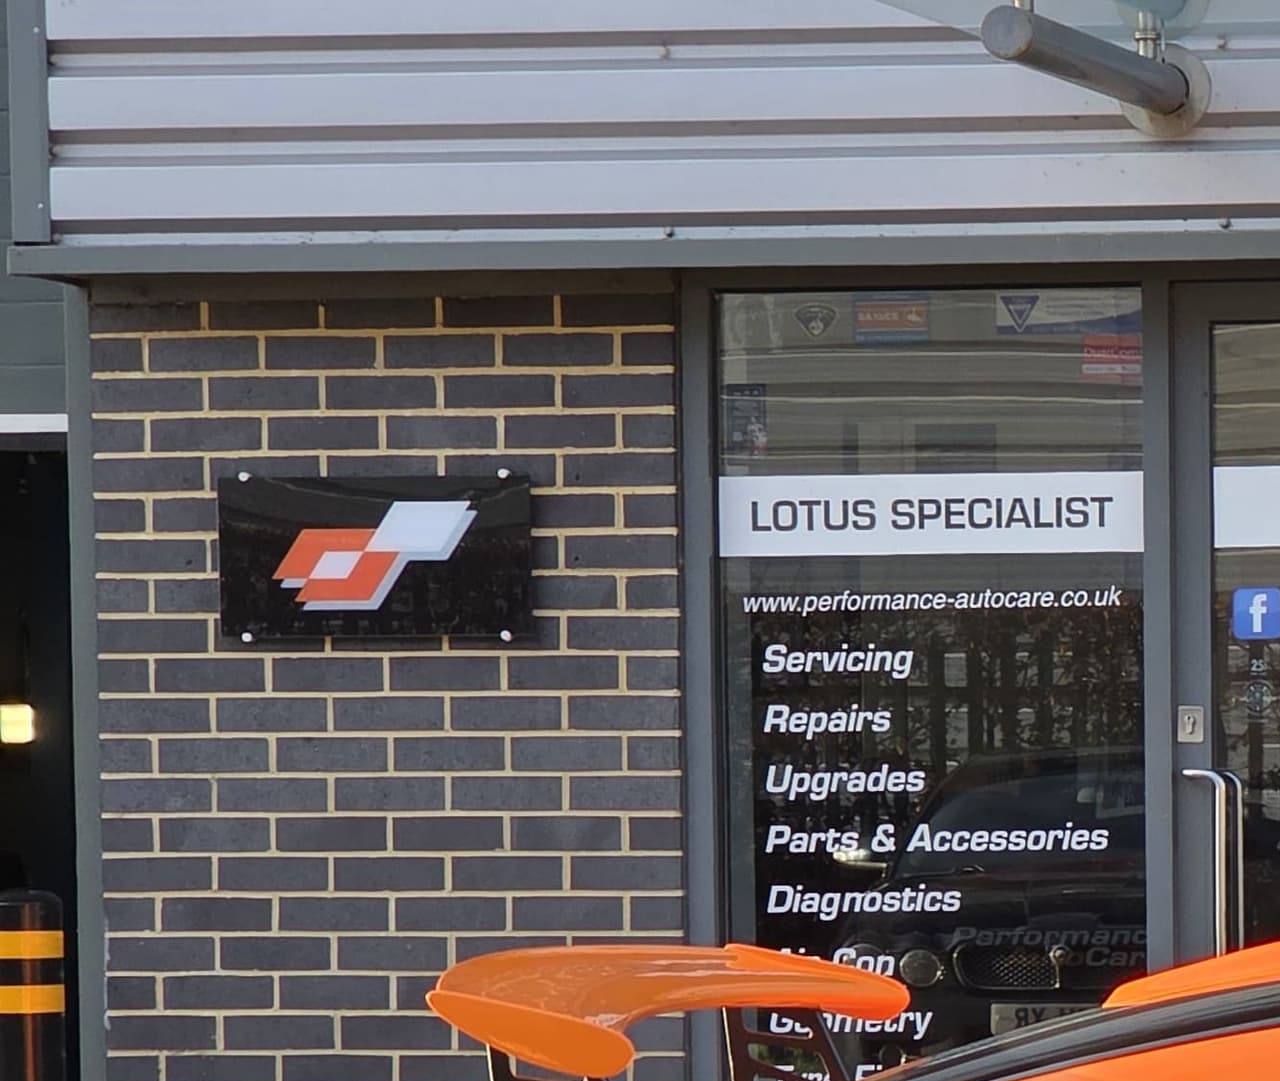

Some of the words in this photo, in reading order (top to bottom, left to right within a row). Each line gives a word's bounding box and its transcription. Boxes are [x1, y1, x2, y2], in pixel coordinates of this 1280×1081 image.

[751, 499, 876, 532] LOTUS
[891, 496, 1114, 530] SPECIALIST
[743, 585, 1122, 615] www.performance-autocare.co.uk
[762, 643, 914, 679] Servicing
[763, 703, 891, 740] Repairs
[766, 764, 926, 801] Upgrades
[765, 825, 860, 853] Parts
[871, 823, 896, 853] &
[906, 822, 1109, 852] Accessories
[767, 883, 962, 921] Diagnostics
